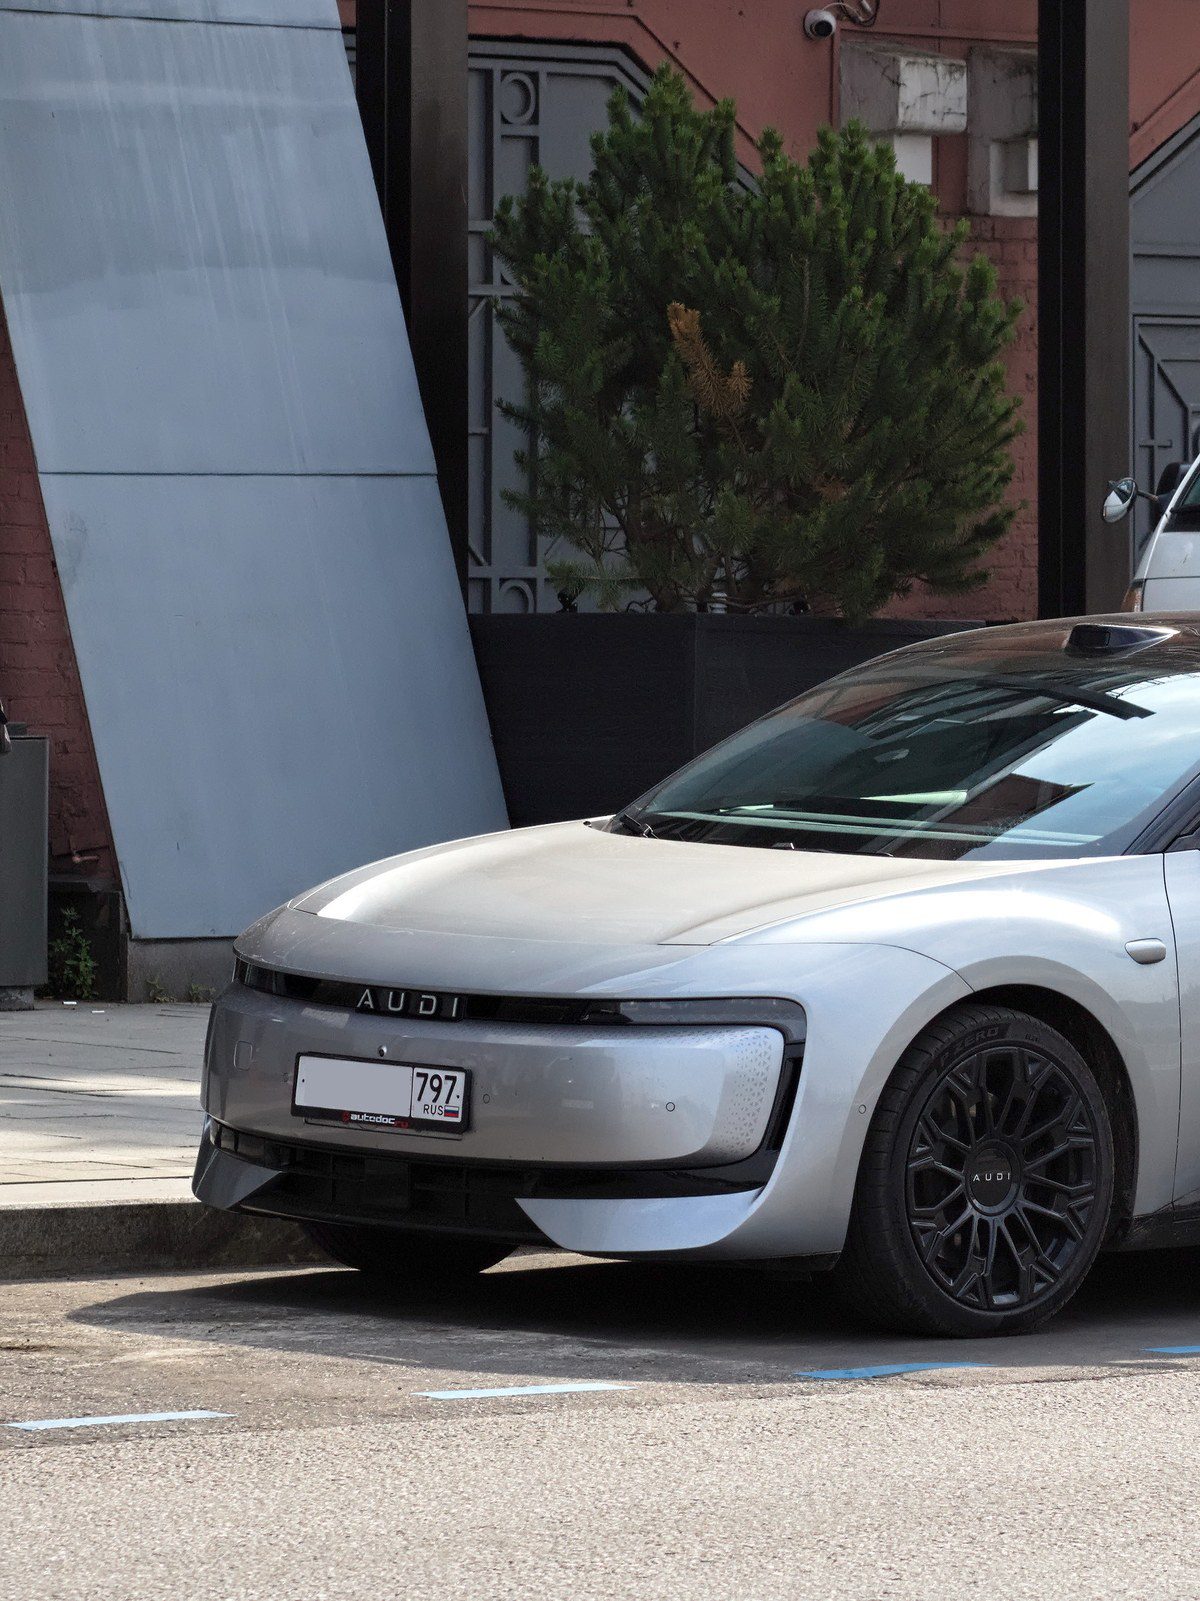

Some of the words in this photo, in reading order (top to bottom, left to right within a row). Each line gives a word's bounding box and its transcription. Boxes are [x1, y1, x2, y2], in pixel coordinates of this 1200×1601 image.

[356, 988, 459, 1018] AUDI
[416, 1071, 457, 1104] 797
[423, 1103, 444, 1116] RUS
[972, 1172, 1010, 1182] AUDI
